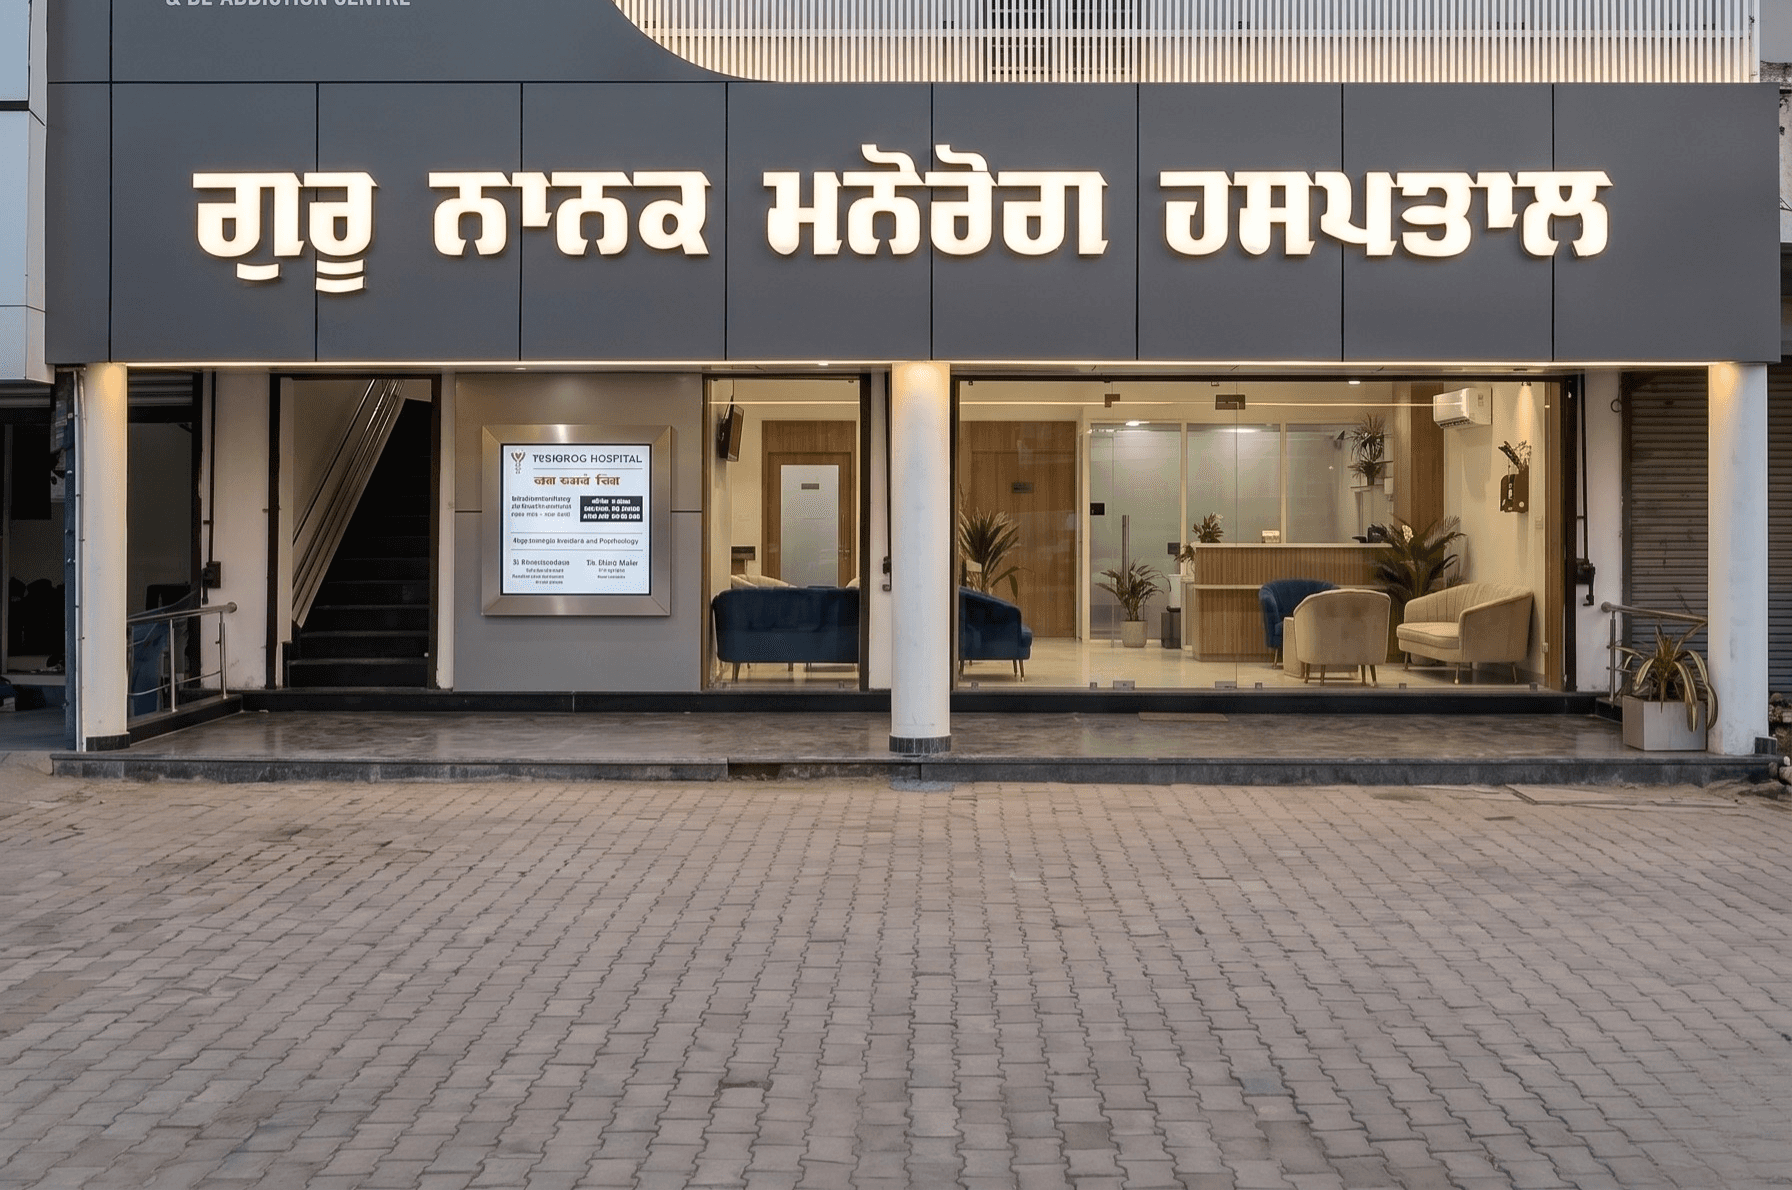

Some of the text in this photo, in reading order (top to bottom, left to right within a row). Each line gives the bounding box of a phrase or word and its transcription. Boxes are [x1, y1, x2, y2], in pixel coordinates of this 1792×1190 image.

[192, 143, 1614, 293] ਗੁਰੂ ਨਾਨਕ ਮਨੋਰੋਗ ਹਸਪਤਾਲ
[590, 453, 643, 464] HOSPITAL
